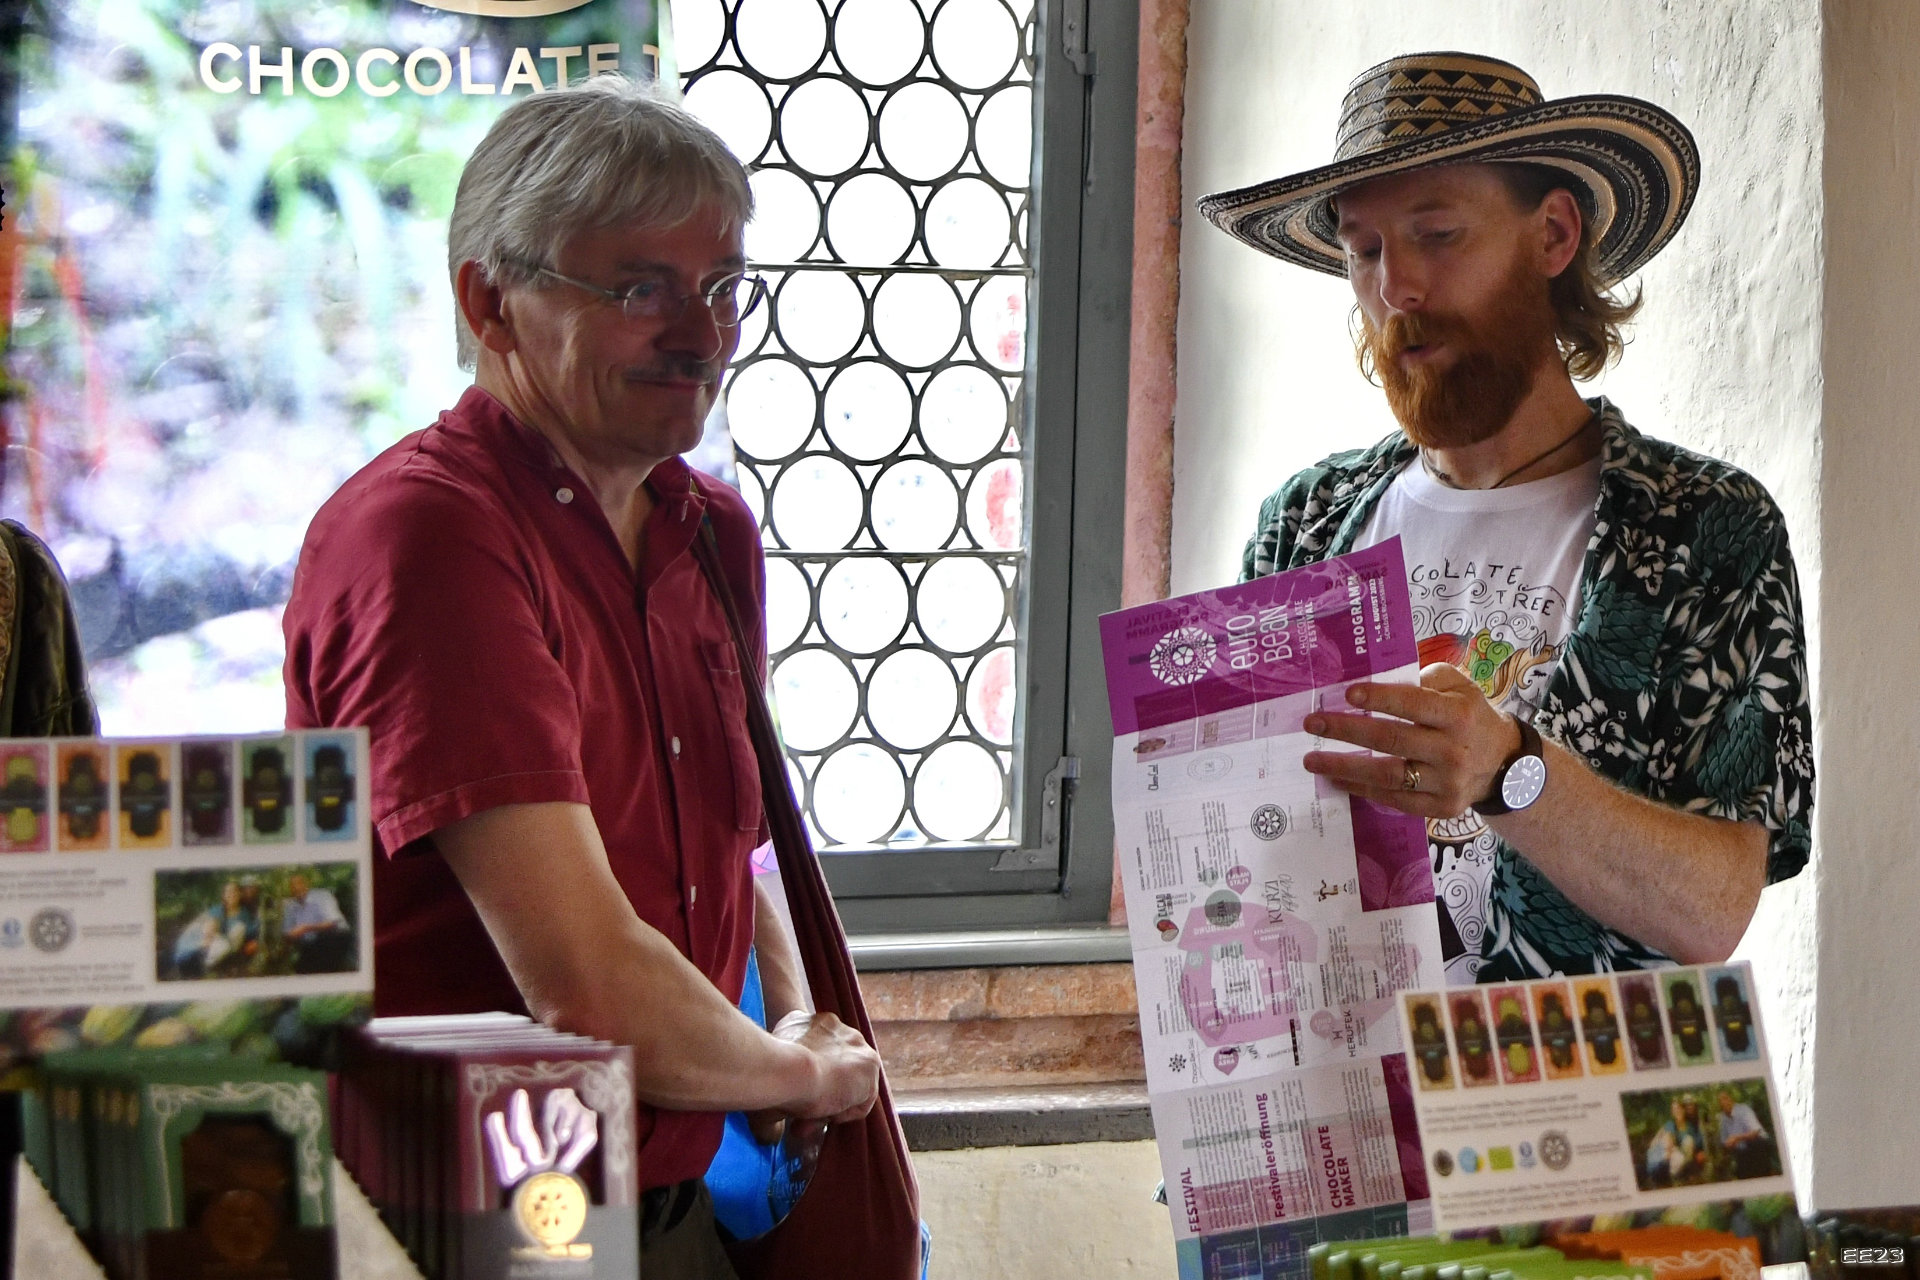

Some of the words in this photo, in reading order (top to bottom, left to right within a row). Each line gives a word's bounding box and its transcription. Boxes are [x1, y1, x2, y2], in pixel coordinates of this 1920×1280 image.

[199, 42, 621, 97] CHOCOLATE
[1294, 599, 1309, 656] CHOCOLATE
[1305, 601, 1319, 649] FESTIVAL
[1347, 574, 1368, 655] PROGRAMM
[1370, 596, 1380, 622] AUGUST
[1495, 589, 1555, 616] TREE
[1225, 614, 1260, 670] euro
[1256, 1092, 1285, 1218] Festivaleröffnung
[1317, 1125, 1343, 1209] CHOCOLATE
[1337, 1156, 1356, 1207] MAKER
[1180, 1167, 1202, 1233] FESTIVAL
